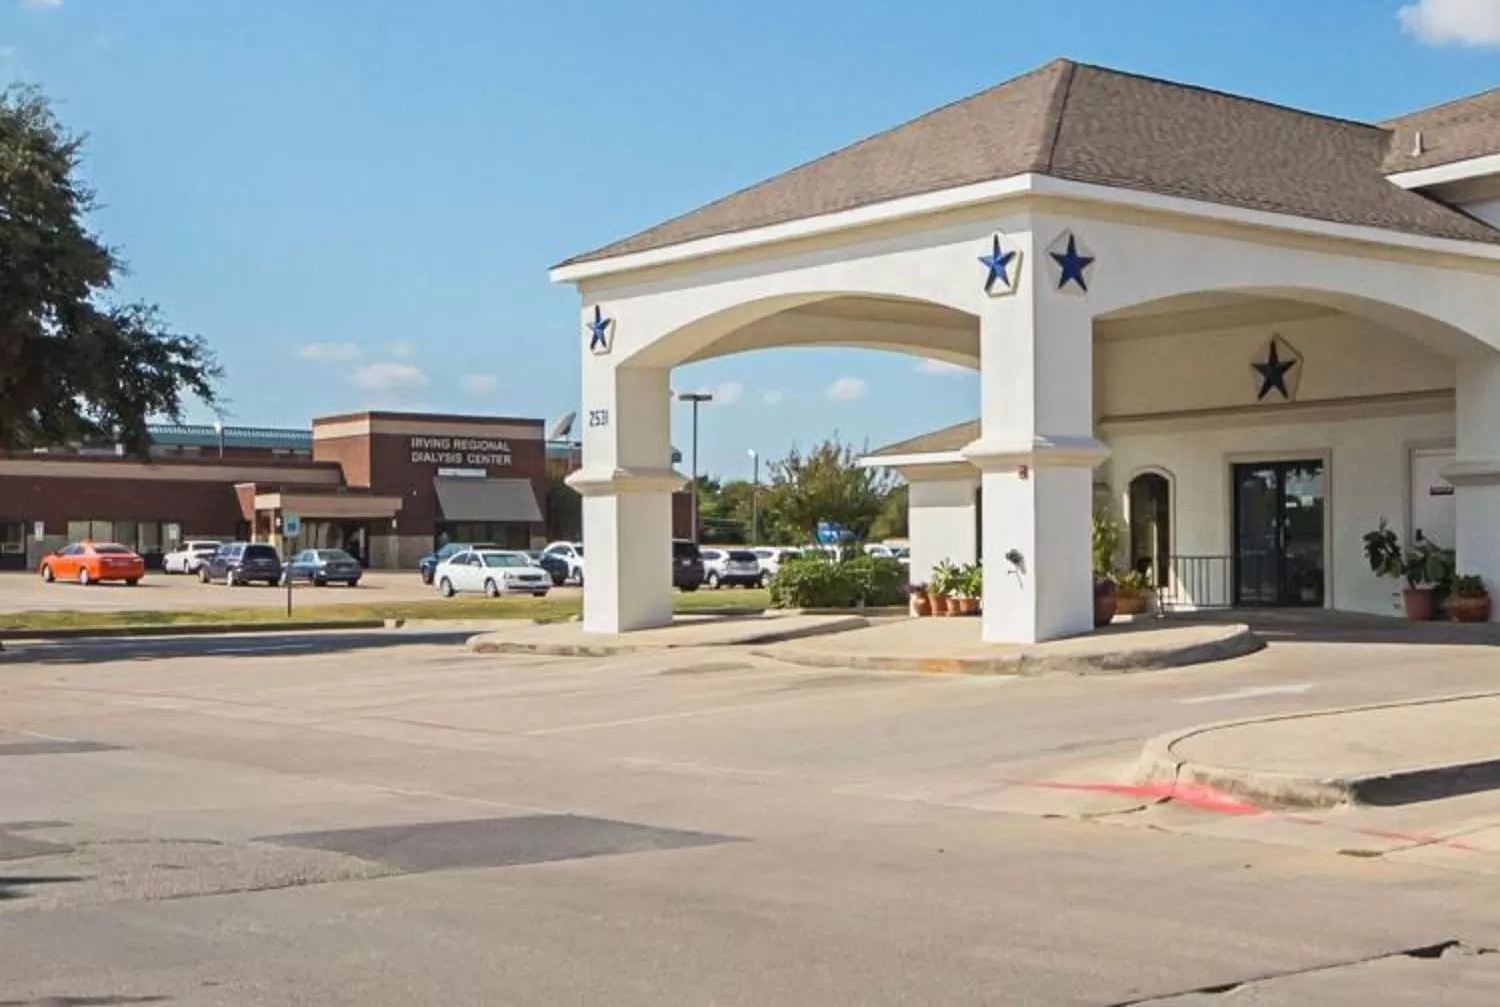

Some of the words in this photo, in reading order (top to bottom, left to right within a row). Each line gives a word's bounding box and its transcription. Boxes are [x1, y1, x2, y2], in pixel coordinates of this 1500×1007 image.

[589, 409, 608, 427] 2531
[411, 436, 450, 449] IRVING
[453, 439, 510, 451] REGIONAL
[411, 452, 463, 464] DIALYSIS
[467, 454, 512, 465] CENTER
